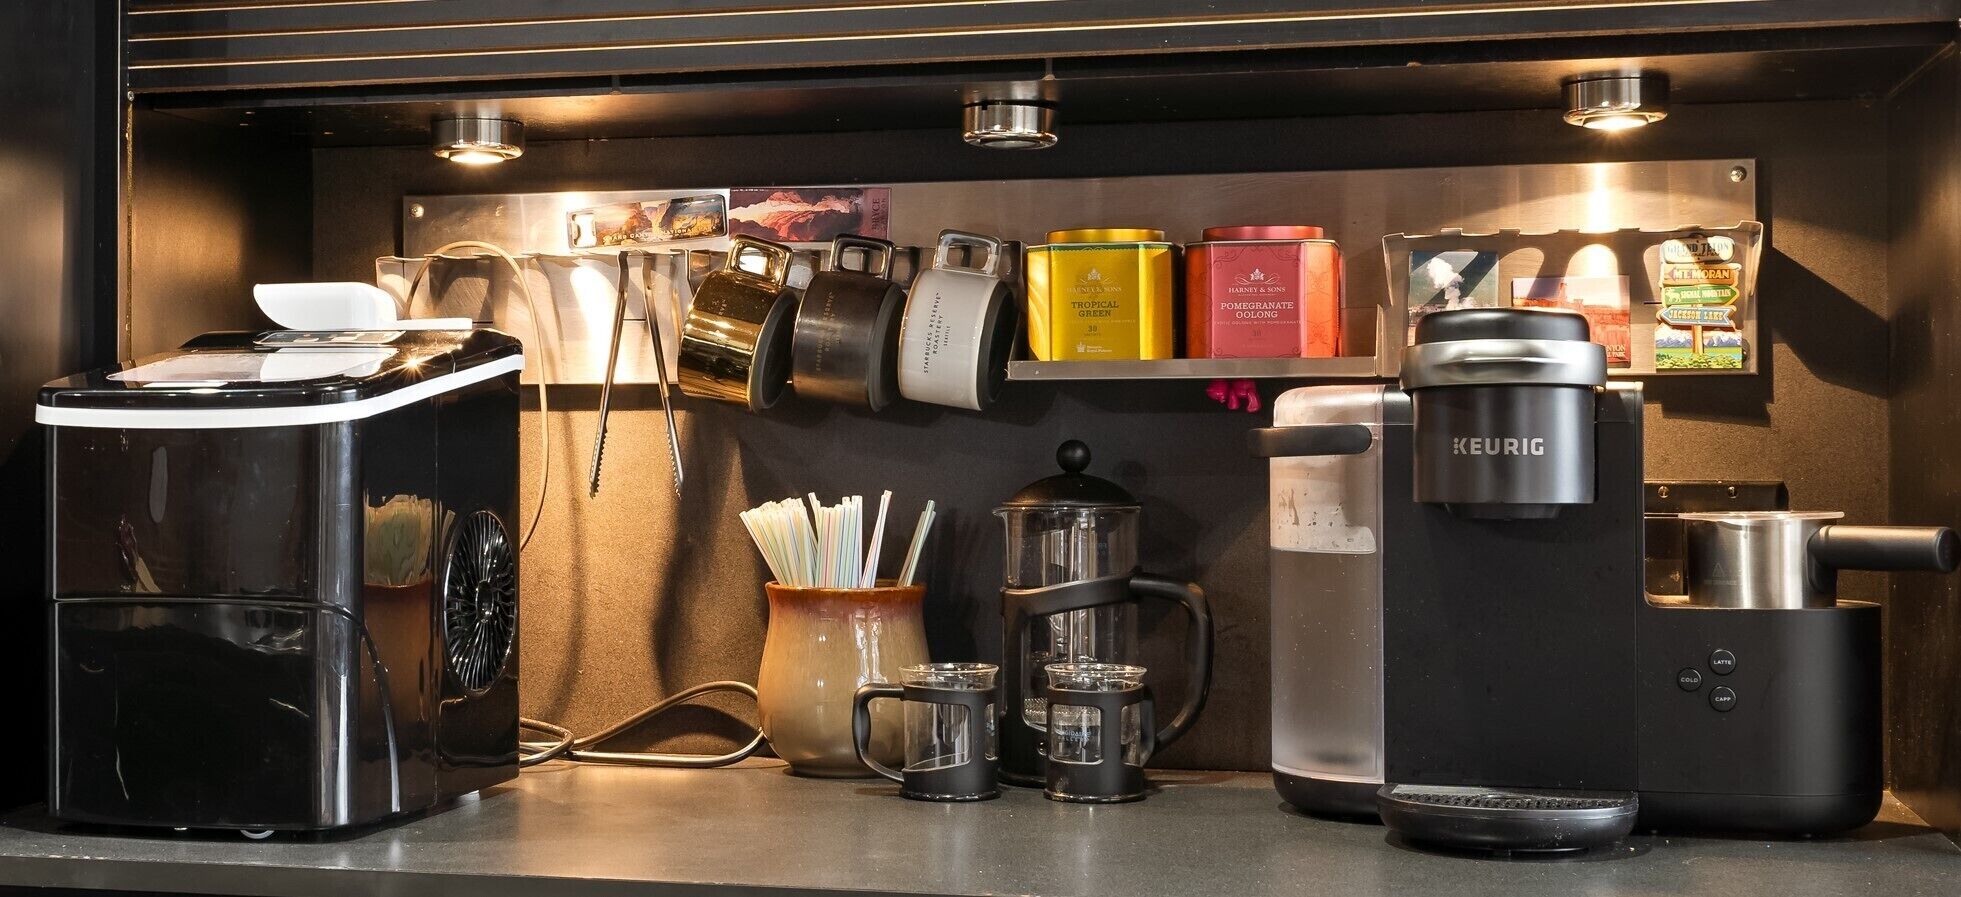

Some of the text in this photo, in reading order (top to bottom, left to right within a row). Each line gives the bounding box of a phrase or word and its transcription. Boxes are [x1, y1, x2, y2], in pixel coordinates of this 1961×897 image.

[1667, 243, 1698, 253] GRAND
[1691, 269, 1730, 280] MORAN
[1071, 300, 1120, 309] TROPICAL
[1220, 301, 1294, 310] POMEGRANATE
[1078, 309, 1112, 318] GREEN
[1235, 310, 1278, 319] OOLONG
[1669, 309, 1724, 320] JACKSON LAKE
[932, 315, 944, 355] ROASTERY
[923, 332, 933, 374] STARBUCKS
[1453, 437, 1544, 456] KEURIG
